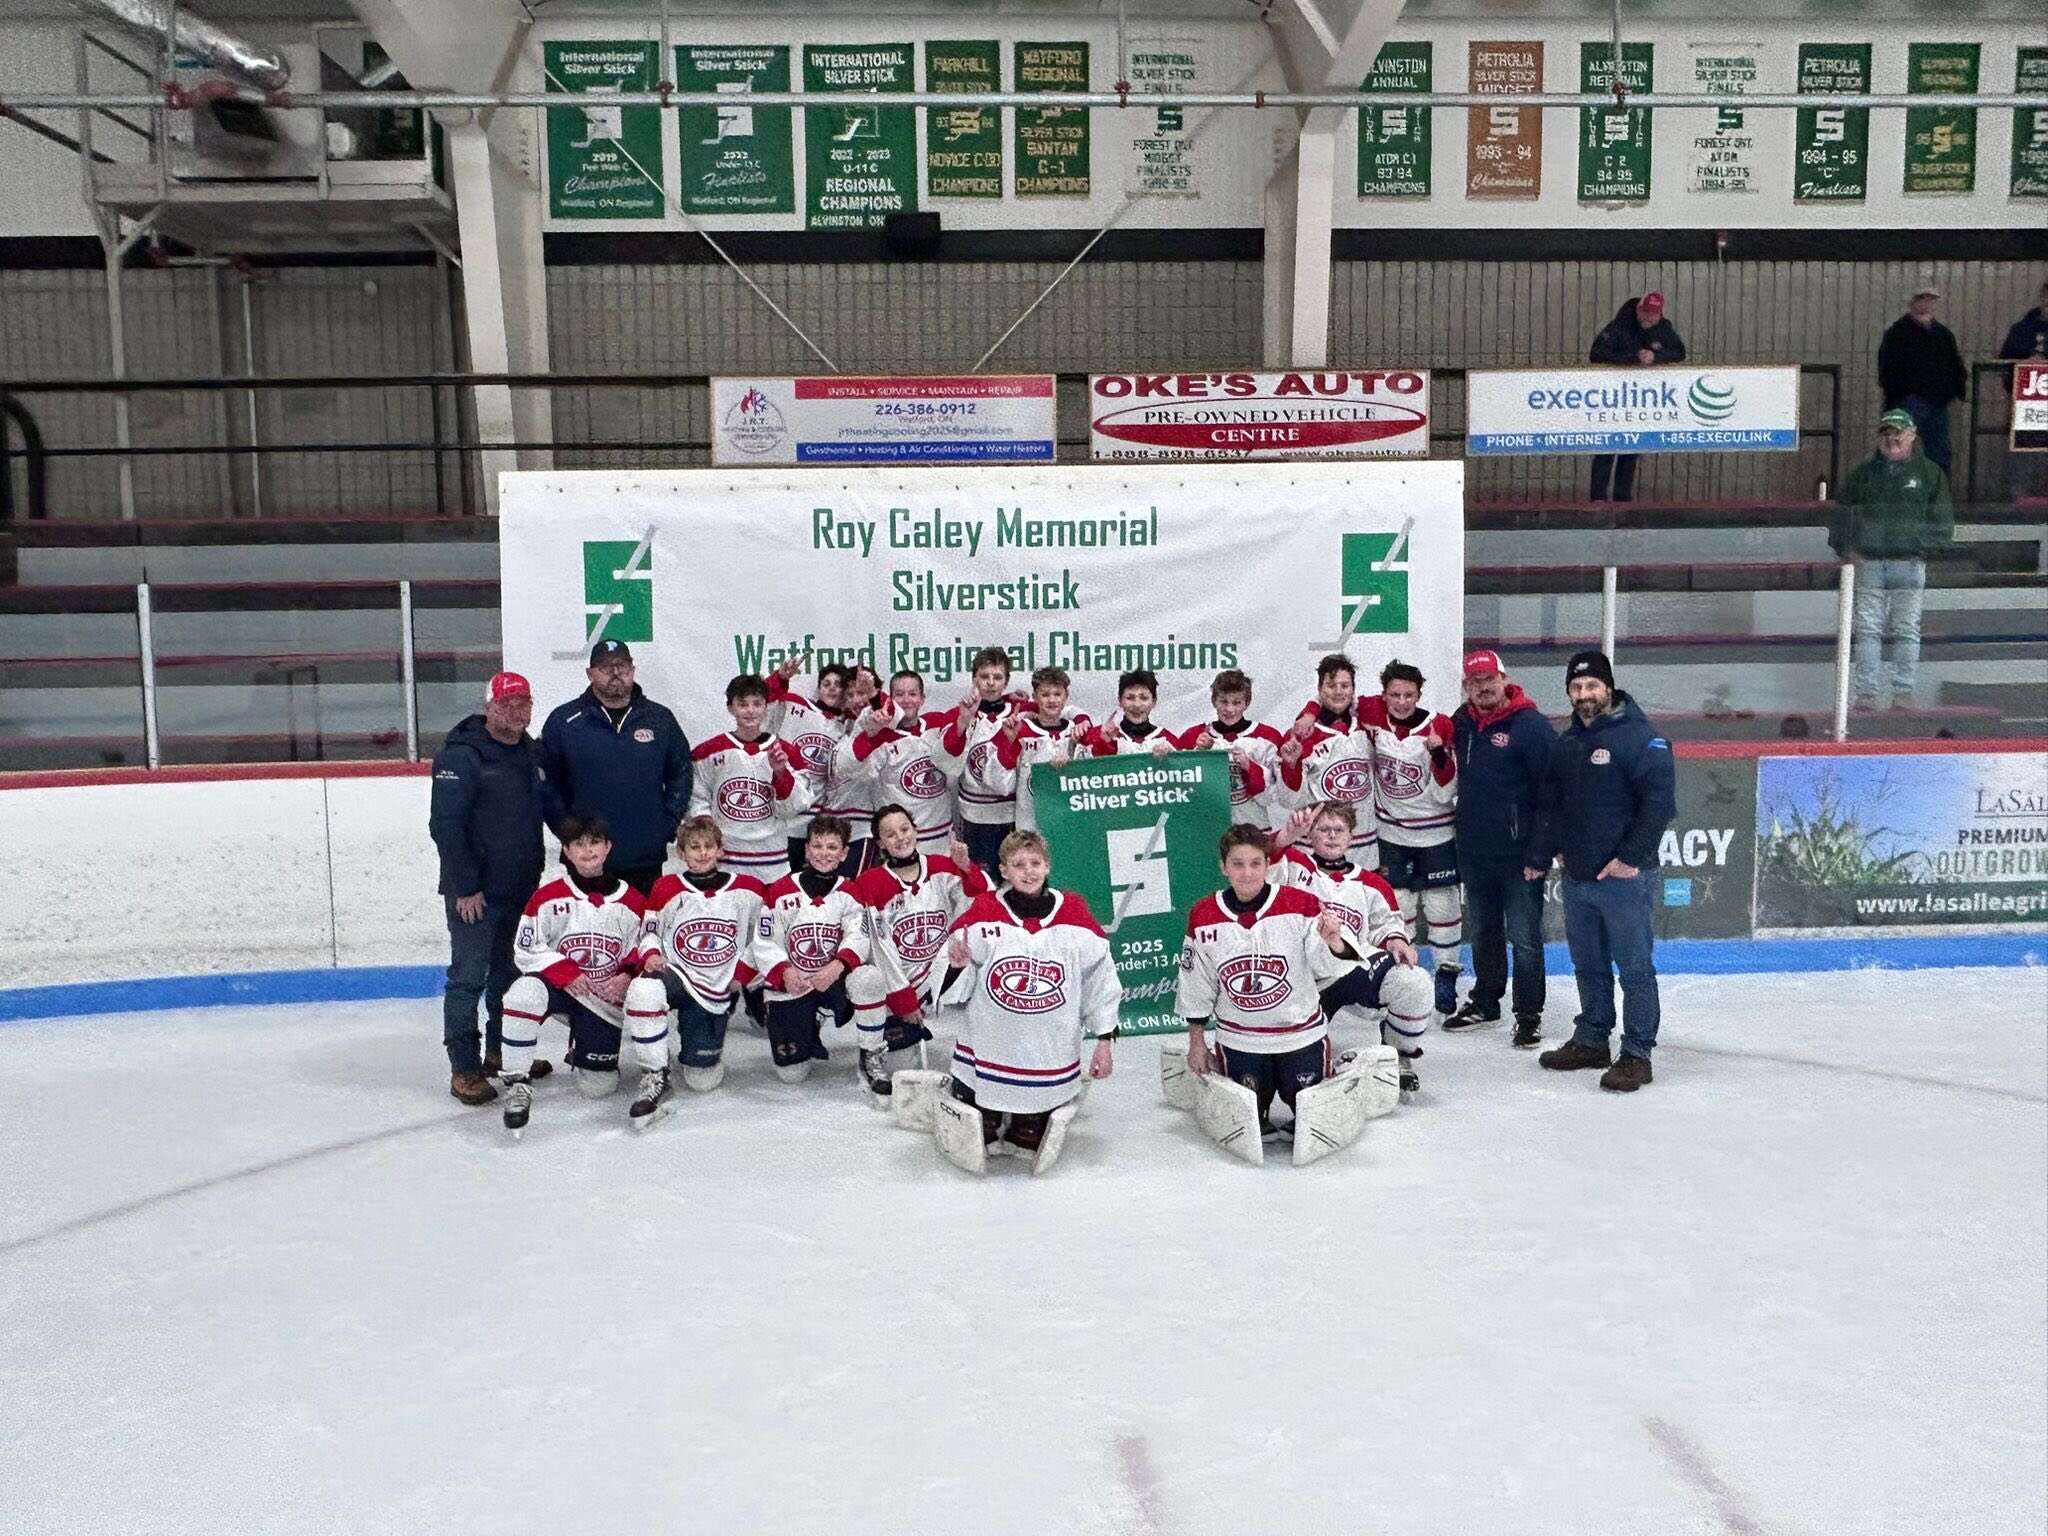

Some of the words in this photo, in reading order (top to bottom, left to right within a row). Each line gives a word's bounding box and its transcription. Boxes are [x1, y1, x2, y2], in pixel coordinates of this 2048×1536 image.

[695, 60, 732, 71] Silver
[811, 51, 906, 68] INTERNATIONAL
[1370, 58, 1427, 74] LVINSTON
[1477, 52, 1535, 68] PETROLIA
[1804, 58, 1861, 74] PETROLIA
[565, 63, 601, 74] Silver
[824, 69, 861, 84] SILVER
[864, 68, 896, 84] STICK
[1474, 70, 1507, 81] SILVER
[1372, 77, 1419, 89] ANNUAL
[869, 162, 879, 173] C
[826, 177, 896, 193] REGIONAL
[1017, 177, 1089, 192] CHAMPIONS
[1364, 182, 1426, 193] CHAMPIONS
[1584, 184, 1646, 196] CHAMPIONS
[820, 195, 903, 211] CHAMPIONS
[827, 387, 867, 396] INSTALL
[877, 386, 918, 396] SERVICE
[928, 386, 978, 395] MAINTAIN
[987, 385, 1023, 395] REPAIR
[1094, 374, 1257, 398] OKE'S
[1274, 372, 1424, 397] AUTO
[1527, 378, 1679, 410] execulink
[875, 403, 977, 416] 226-386-0912
[1144, 409, 1278, 424] PRE-OWNED
[1283, 407, 1377, 421] VEHICLE
[1585, 411, 1680, 422] TELECOM
[1210, 428, 1300, 443] CENTRE
[1486, 434, 1535, 447] PHONE
[1544, 434, 1611, 447] INTERNET
[1616, 433, 1640, 445] TV
[1660, 430, 1773, 444] 1-855-EXECULINK
[908, 444, 921, 454] Air
[986, 443, 1011, 453] Water
[813, 508, 876, 557] Roy
[889, 508, 984, 557] Caley
[996, 506, 1158, 548] Memorial
[892, 569, 1081, 612] Silverstick
[889, 632, 1035, 682] Regioal
[1049, 630, 1239, 673] Champions
[1060, 766, 1202, 792] International
[1069, 793, 1131, 812] Silver
[1135, 787, 1190, 807] Stick
[1657, 827, 1736, 868] ACY
[1121, 939, 1164, 955] 2025
[1115, 955, 1169, 971] nder-13
[1137, 1016, 1160, 1028] ON
